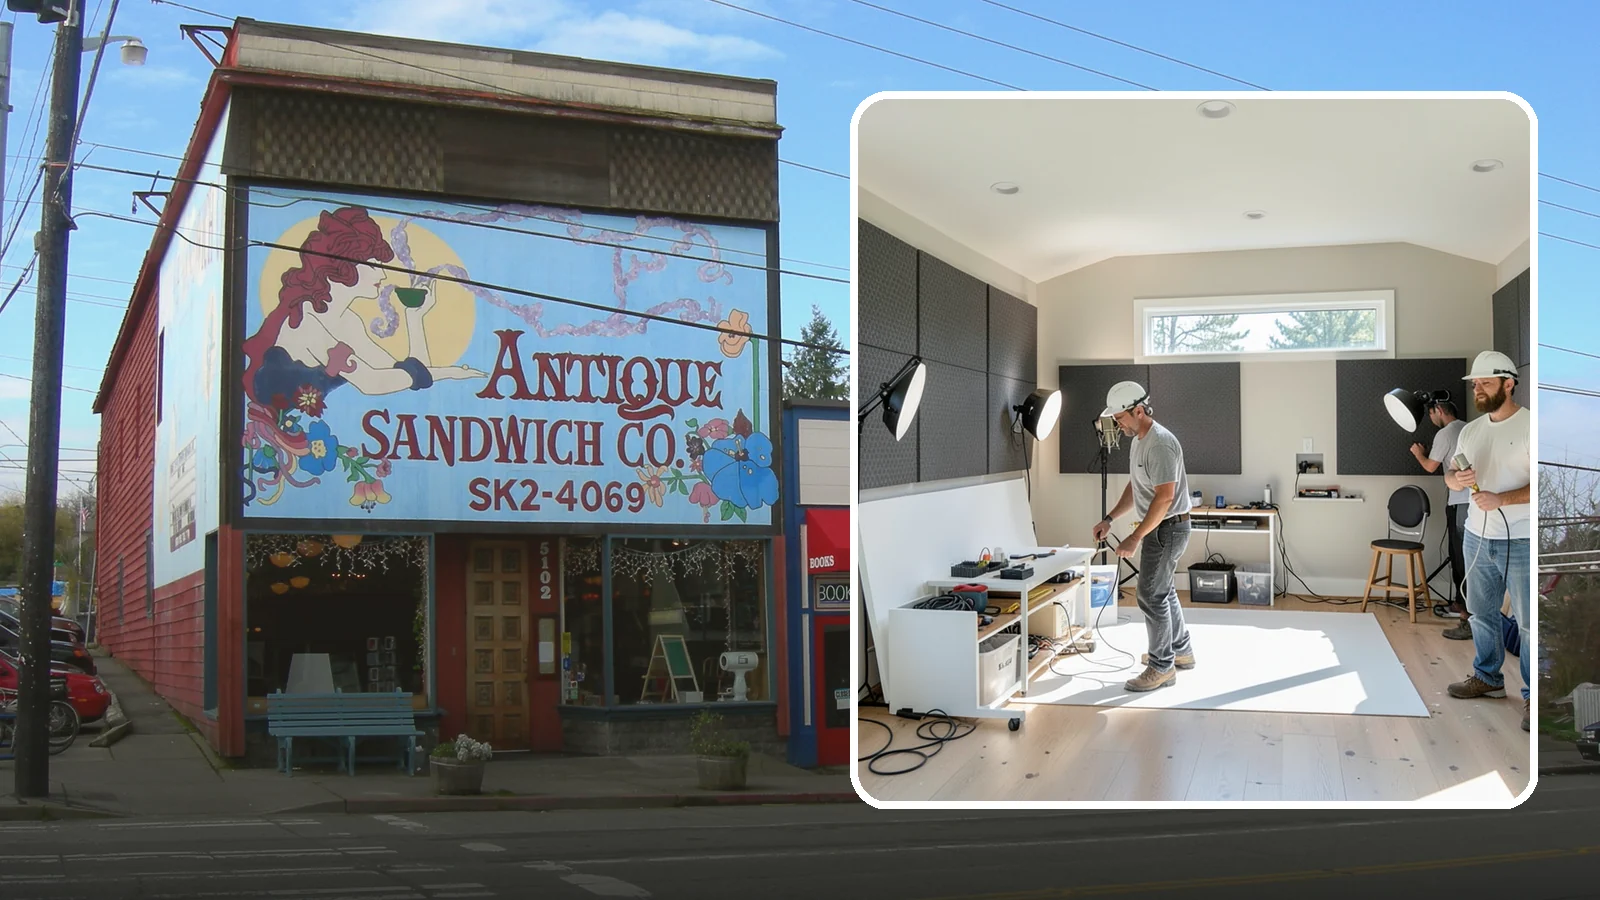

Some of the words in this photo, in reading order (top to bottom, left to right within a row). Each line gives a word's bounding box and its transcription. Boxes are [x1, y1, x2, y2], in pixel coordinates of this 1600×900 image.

[476, 329, 723, 421] ANTIQUE
[361, 408, 604, 467] SANDWICH
[617, 422, 684, 468] CO.
[468, 477, 645, 512] SK2-4069
[540, 542, 551, 599] 5102
[809, 555, 834, 568] BOOKS
